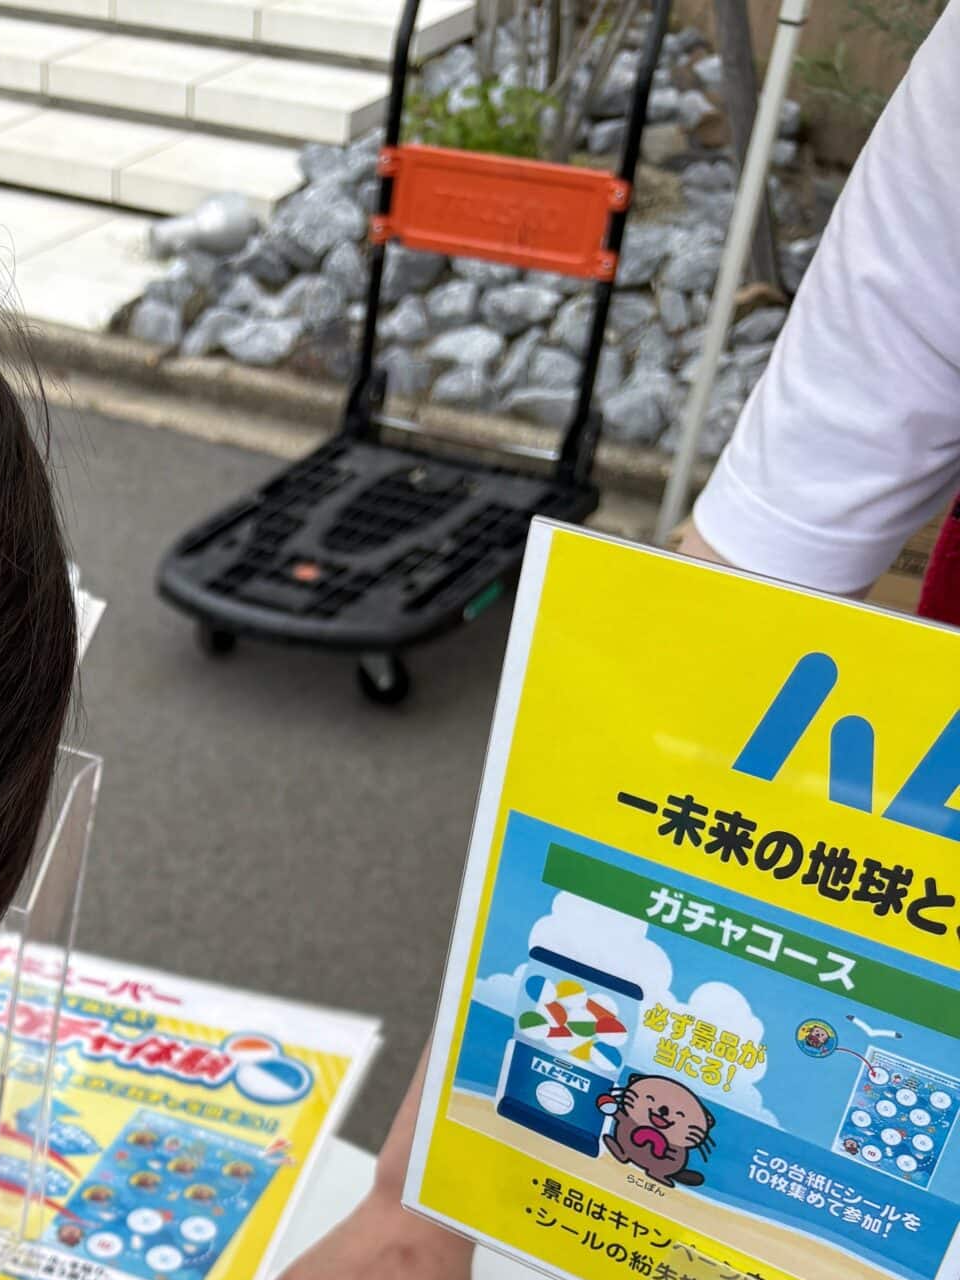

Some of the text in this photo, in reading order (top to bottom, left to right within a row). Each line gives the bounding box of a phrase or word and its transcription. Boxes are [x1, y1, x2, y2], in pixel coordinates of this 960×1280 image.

[645, 888, 857, 990] ガチャコース
[643, 1003, 767, 1069] 必ず景品が
[654, 1038, 737, 1092] 当たる!
[748, 1164, 892, 1239] 10枚集めて参加!
[752, 1149, 921, 1232] この台紙にシールを
